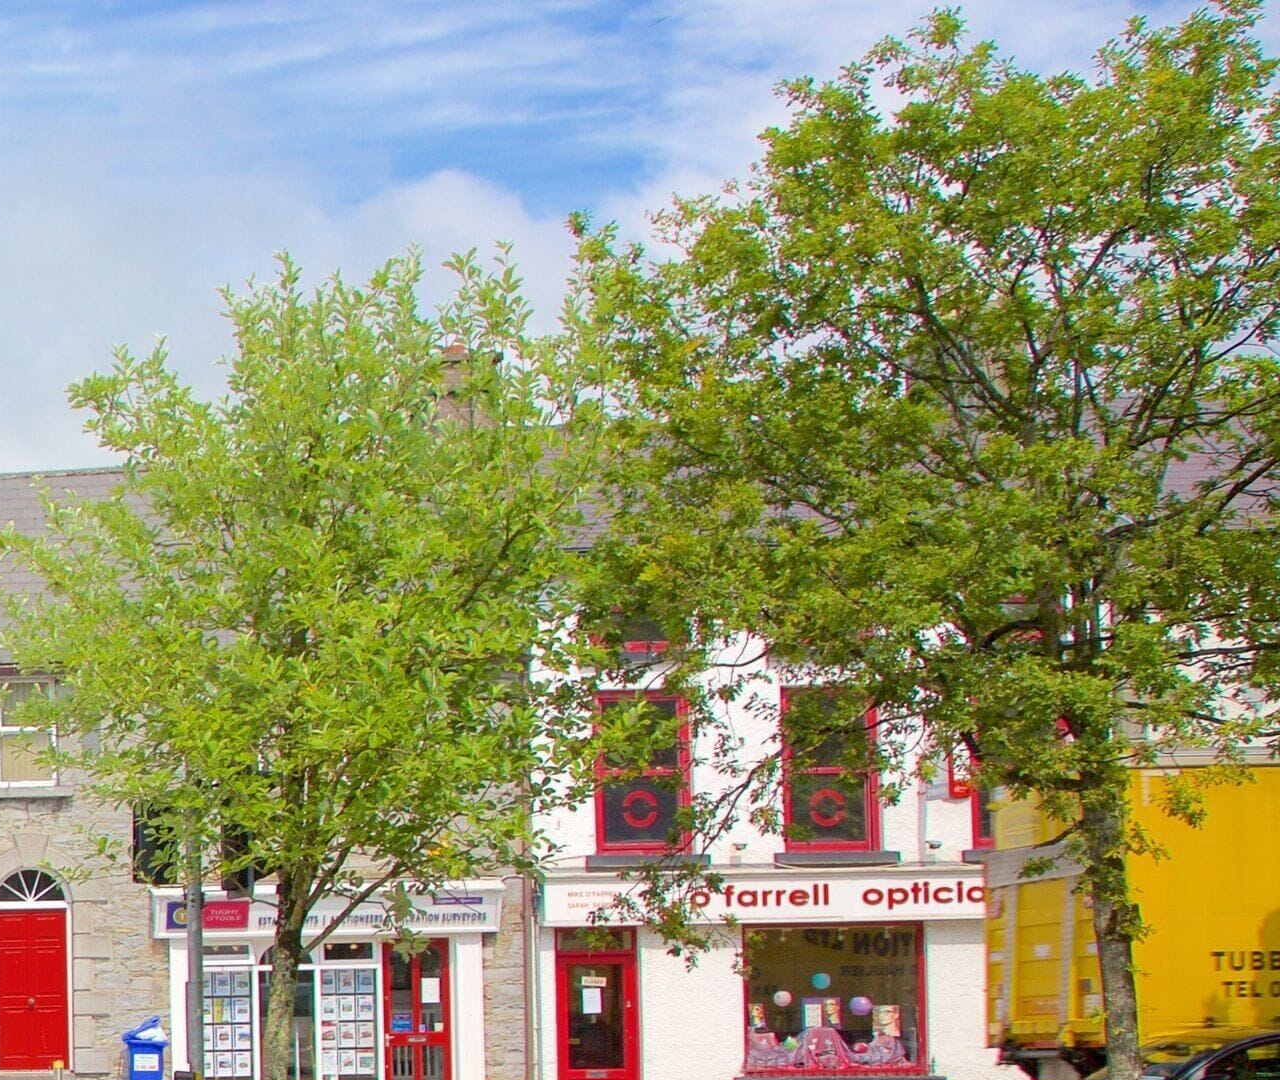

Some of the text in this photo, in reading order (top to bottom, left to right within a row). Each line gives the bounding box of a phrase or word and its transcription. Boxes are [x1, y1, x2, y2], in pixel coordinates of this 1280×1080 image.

[862, 881, 987, 910] opticia
[330, 914, 383, 924] ATIONEERS
[442, 912, 487, 922] SURVEYORS
[1221, 980, 1262, 998] TEL
